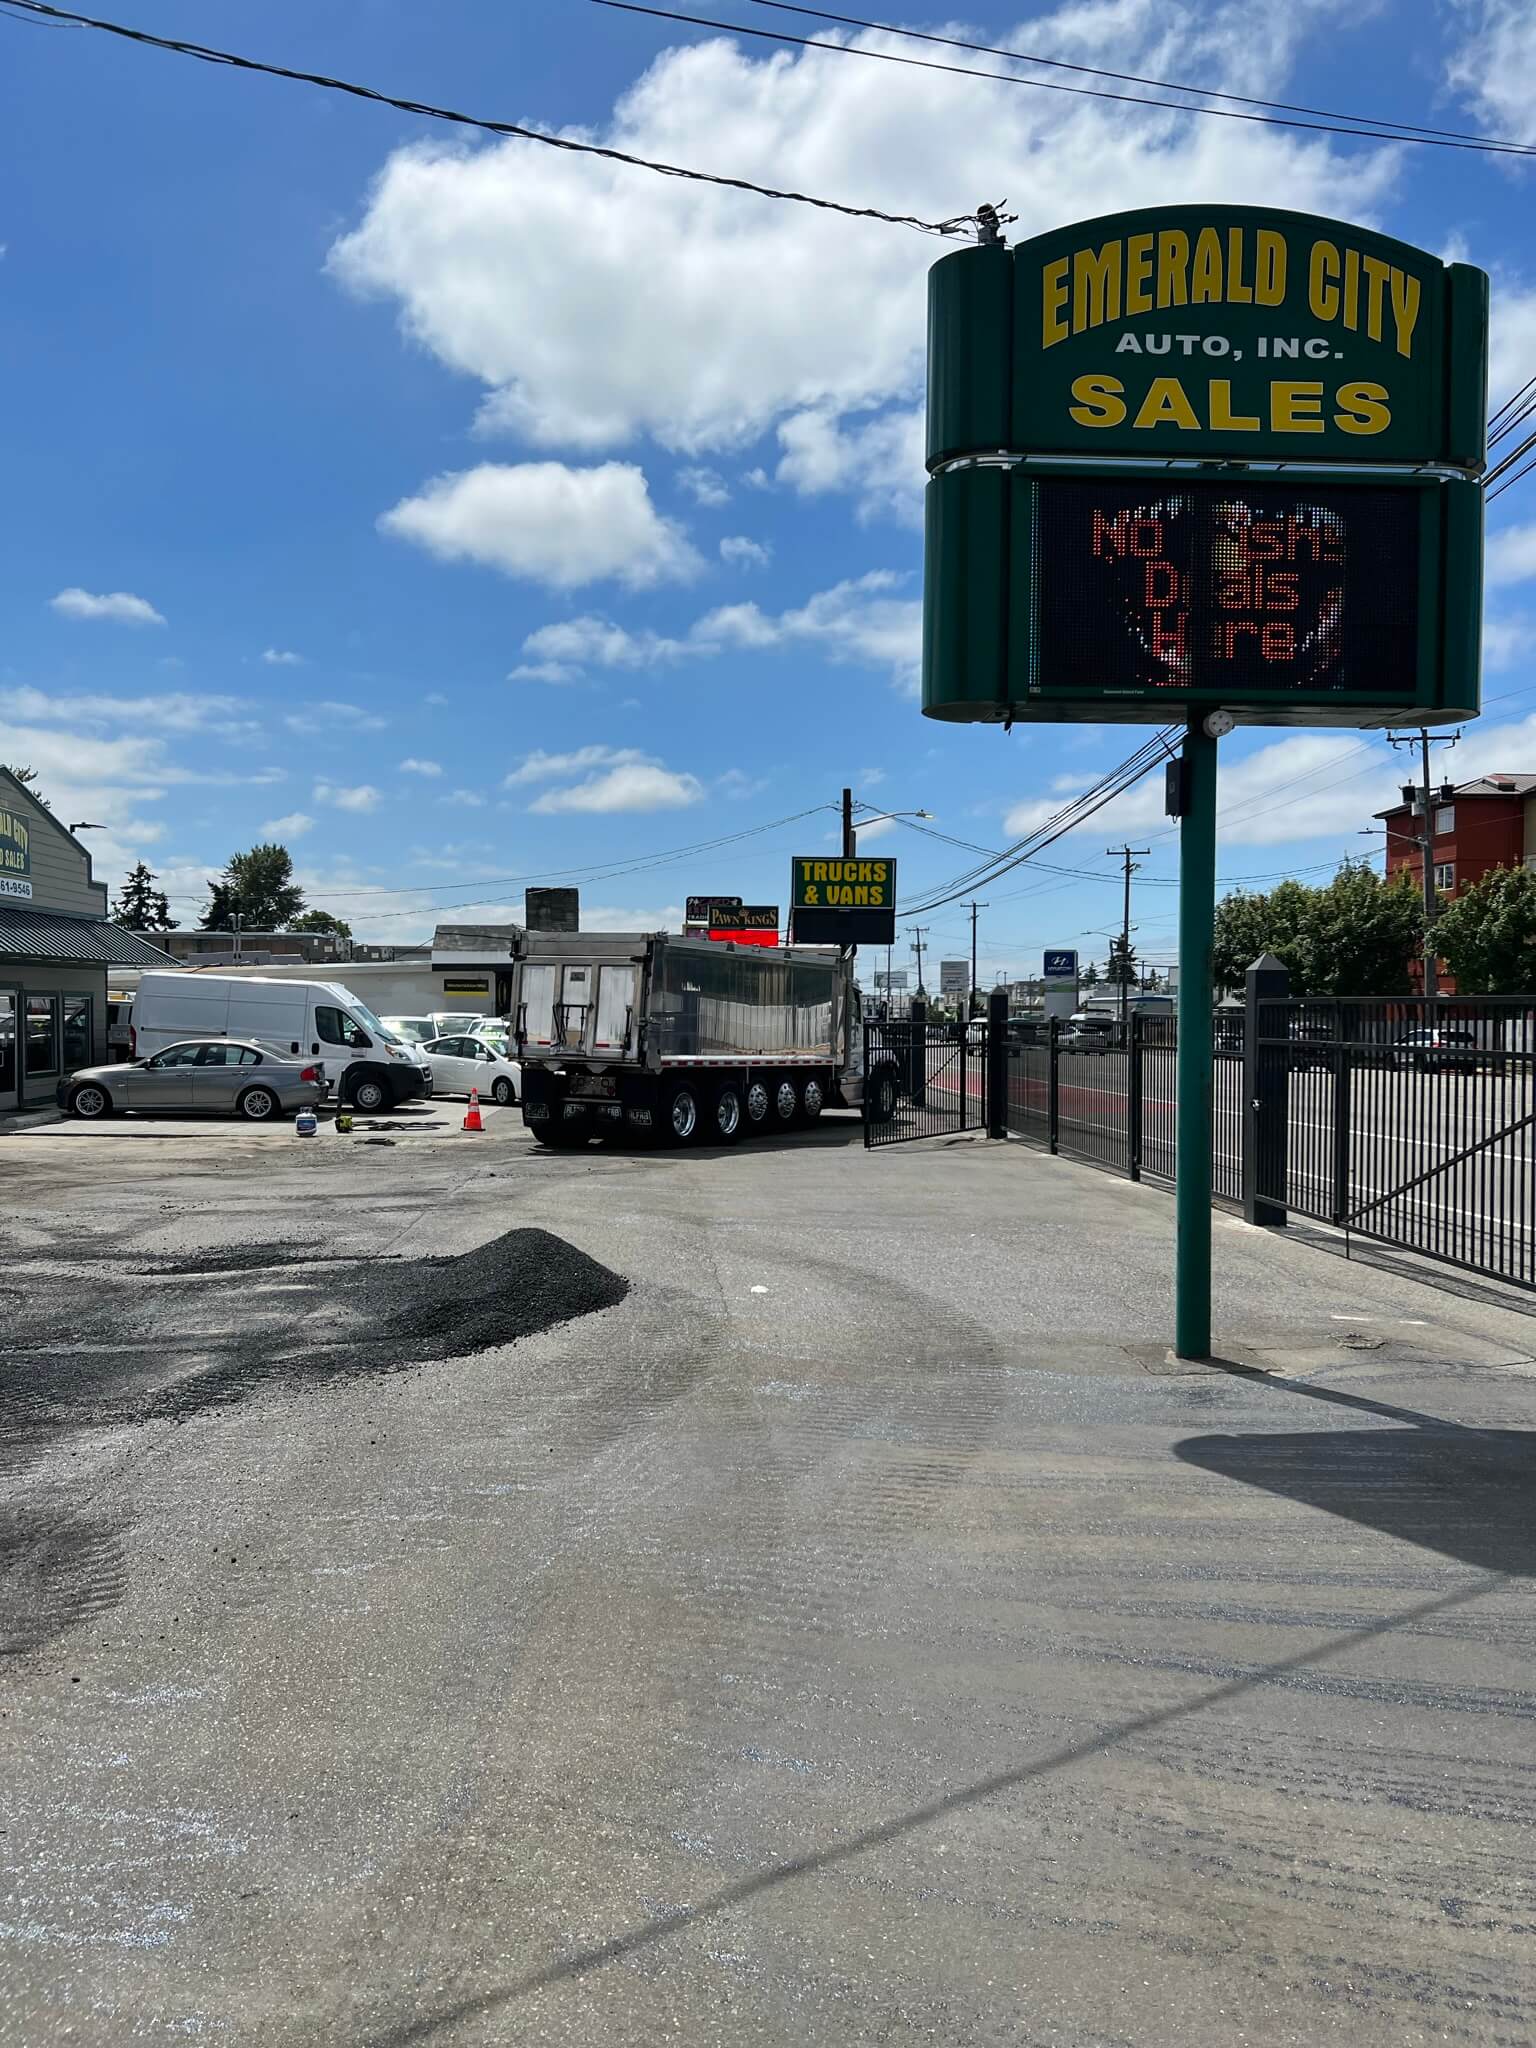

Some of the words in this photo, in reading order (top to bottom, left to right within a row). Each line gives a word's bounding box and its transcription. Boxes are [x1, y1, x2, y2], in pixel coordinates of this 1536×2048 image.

[1042, 227, 1287, 350] EMERALD
[1309, 239, 1421, 359] CITY
[1114, 332, 1243, 362] AUTO,
[1257, 337, 1344, 360] INC.
[1068, 374, 1393, 435] SALES
[1092, 509, 1164, 557] No
[5, 849, 25, 870] SALES
[801, 861, 887, 882] TRUCKS
[804, 885, 819, 905] &
[826, 885, 884, 905] VANS
[712, 908, 740, 925] PAWN
[744, 909, 777, 926] KINGS
